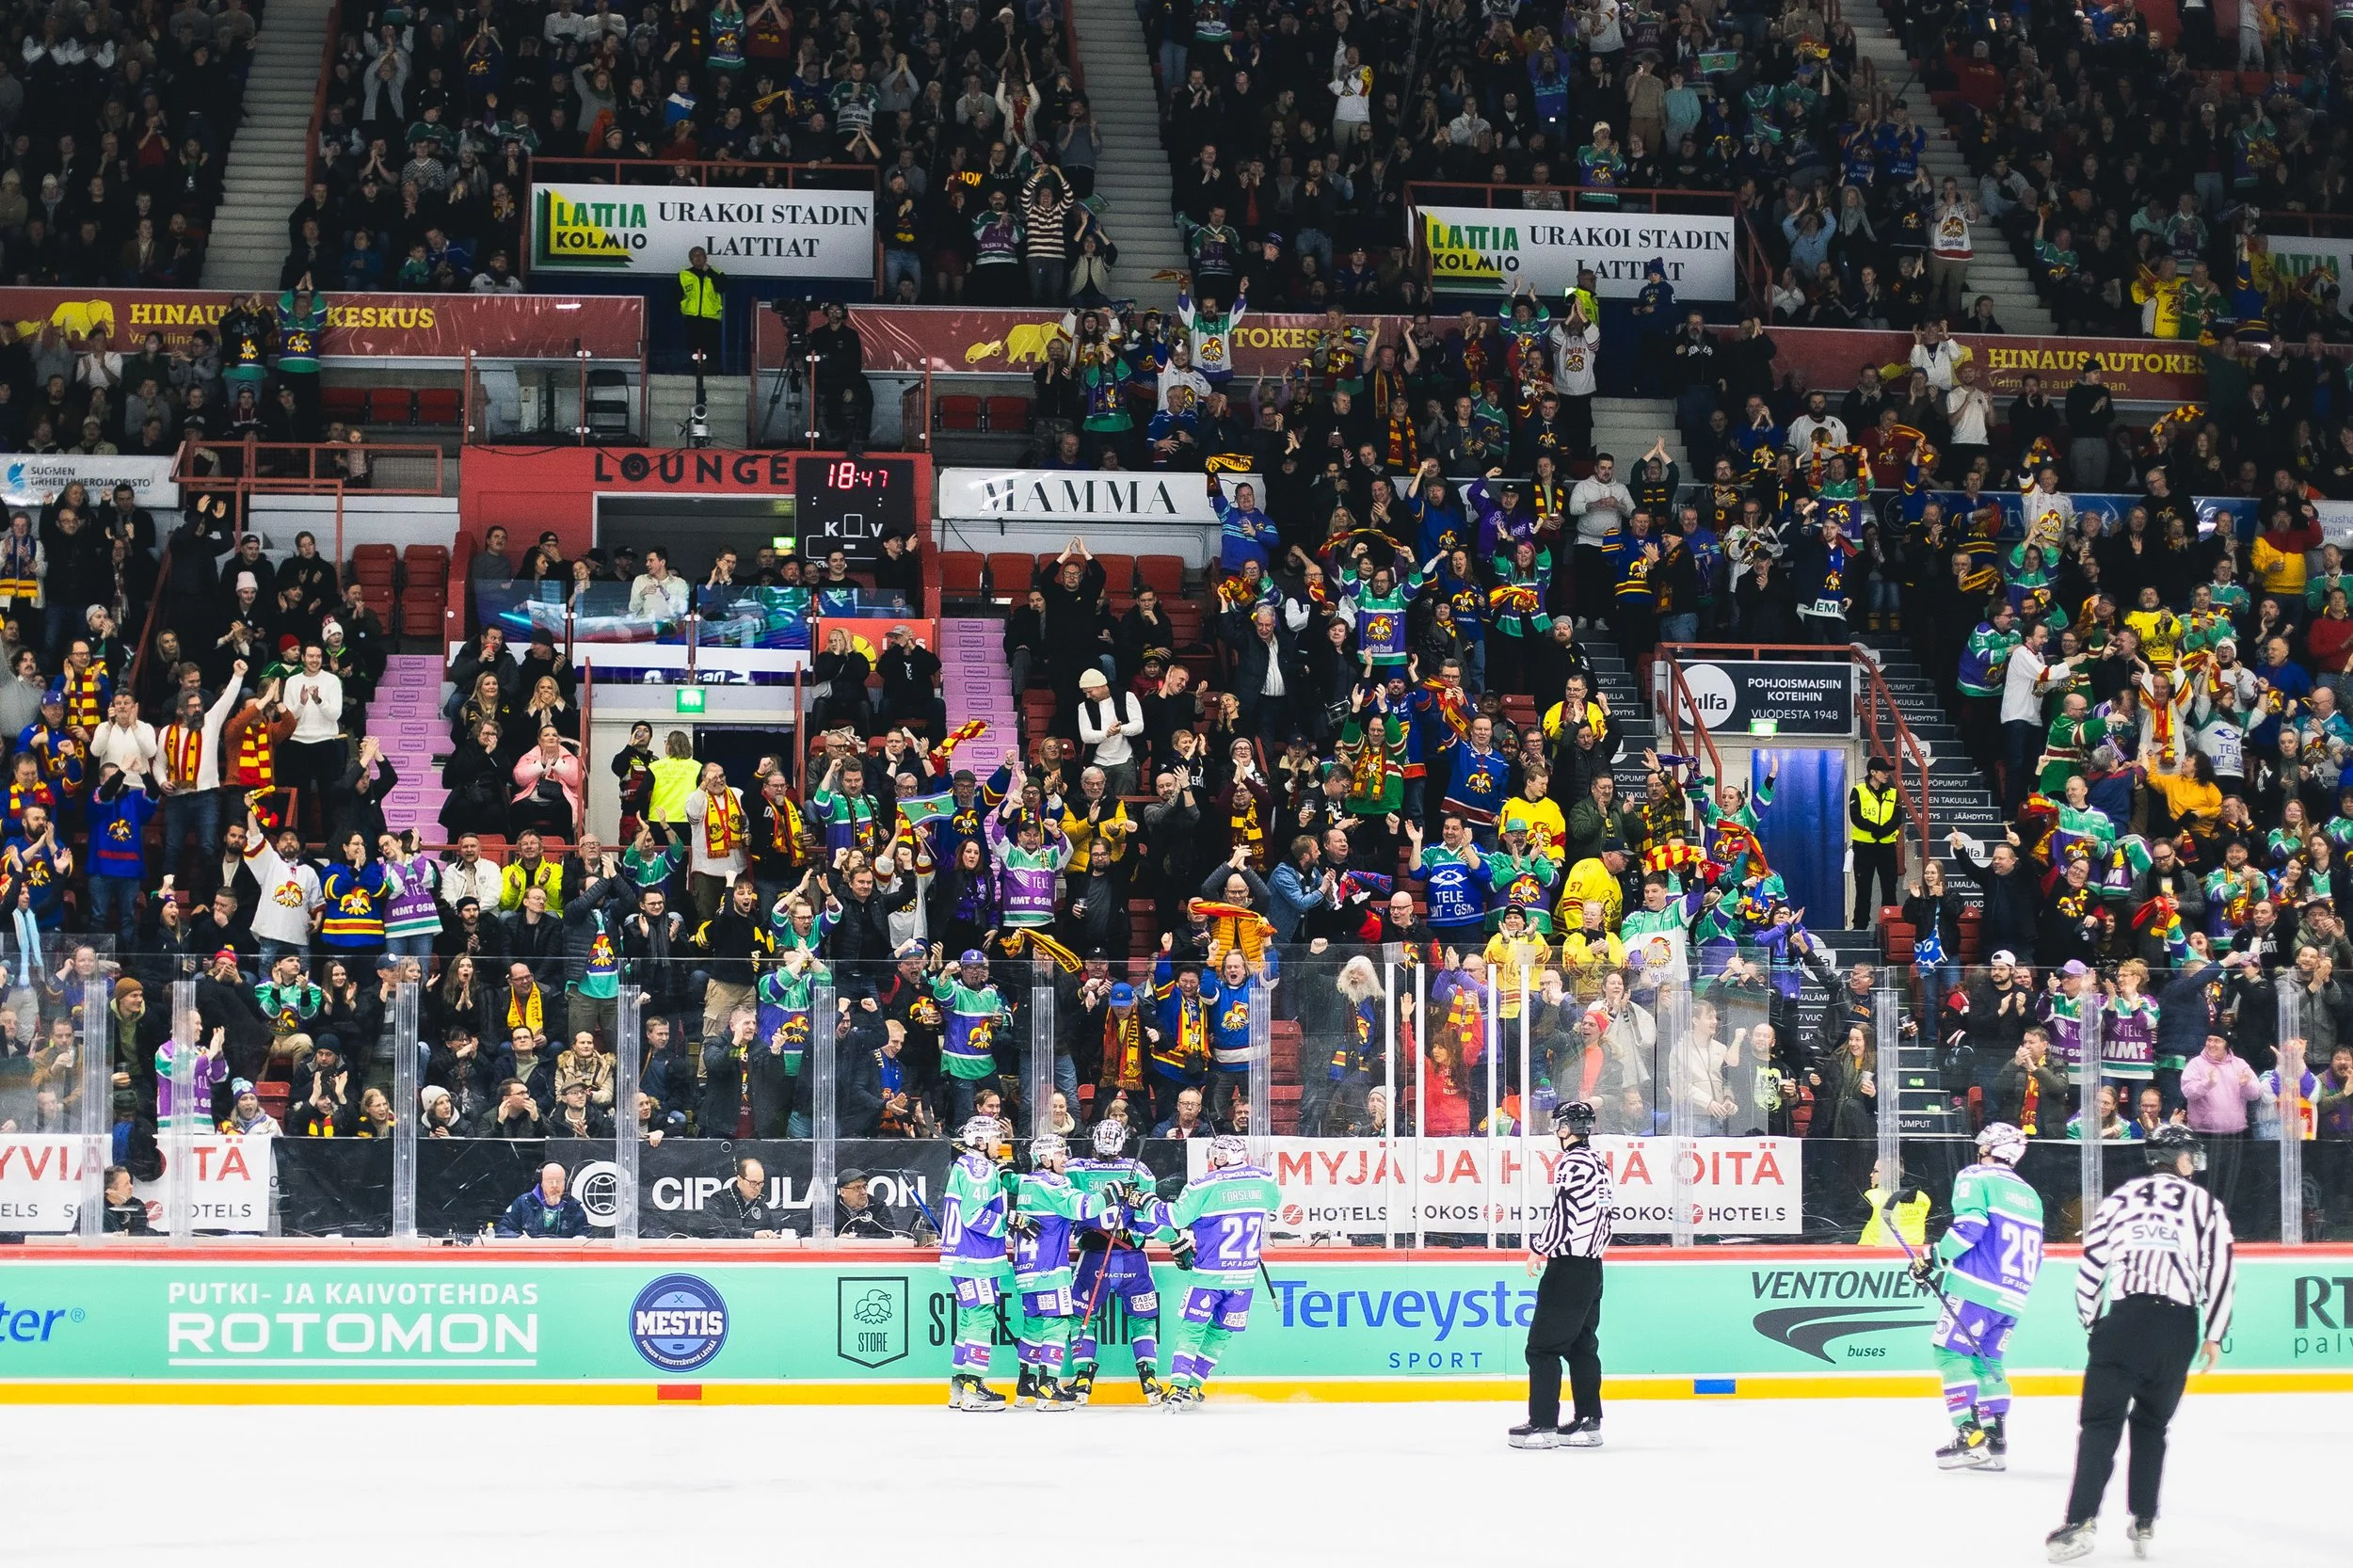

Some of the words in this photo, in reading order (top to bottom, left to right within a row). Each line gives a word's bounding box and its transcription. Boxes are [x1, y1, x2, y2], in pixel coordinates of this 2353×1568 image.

[555, 201, 648, 229] LATTIA
[658, 200, 765, 225] URAKOI
[772, 204, 869, 226] STADIN
[555, 232, 648, 250] KOLMIO
[705, 236, 820, 259] LATTIAT
[1433, 223, 1520, 251] LATTIA
[1529, 225, 1631, 248] URAKOI
[1639, 229, 1731, 250] STADIN
[1433, 253, 1520, 272] KOLMIO
[1576, 259, 1685, 282] LATTIT
[2272, 253, 2339, 281] ATTIA
[594, 452, 791, 486] LOUNGE
[828, 462, 889, 488] 18:47
[980, 478, 1180, 516] MAMMA
[824, 521, 839, 536] K
[871, 523, 884, 538] V
[1748, 678, 1842, 689] POHJOISMAISIIN
[1767, 691, 1823, 702] KOTEIHIN
[1751, 709, 1811, 720] VUODESTA
[1814, 711, 1838, 720] 1948
[1010, 896, 1032, 905] NMT
[1435, 890, 1465, 904] TELE
[392, 904, 414, 917] NMT
[2103, 1040, 2148, 1060] NMT
[1423, 1149, 1481, 1185] JA
[972, 1186, 989, 1201] 40
[1221, 1189, 1263, 1203] FORSLUND
[2134, 1181, 2187, 1212] 43
[1309, 1207, 1388, 1223] HOTELS
[1708, 1207, 1786, 1223] HOTELS
[1219, 1215, 1263, 1260] 22
[2132, 1224, 2181, 1241] SVEA
[2001, 1222, 2041, 1284] 28
[168, 1282, 272, 1304] PUTKI-
[282, 1283, 315, 1304] JA
[325, 1283, 539, 1305] KAIVOTEHDAS
[168, 1312, 538, 1354] ROTOMON
[635, 1310, 724, 1336] MESTIS
[857, 1332, 888, 1352] STORE
[1847, 1344, 1887, 1358] buses
[1388, 1352, 1484, 1368] SPORT
